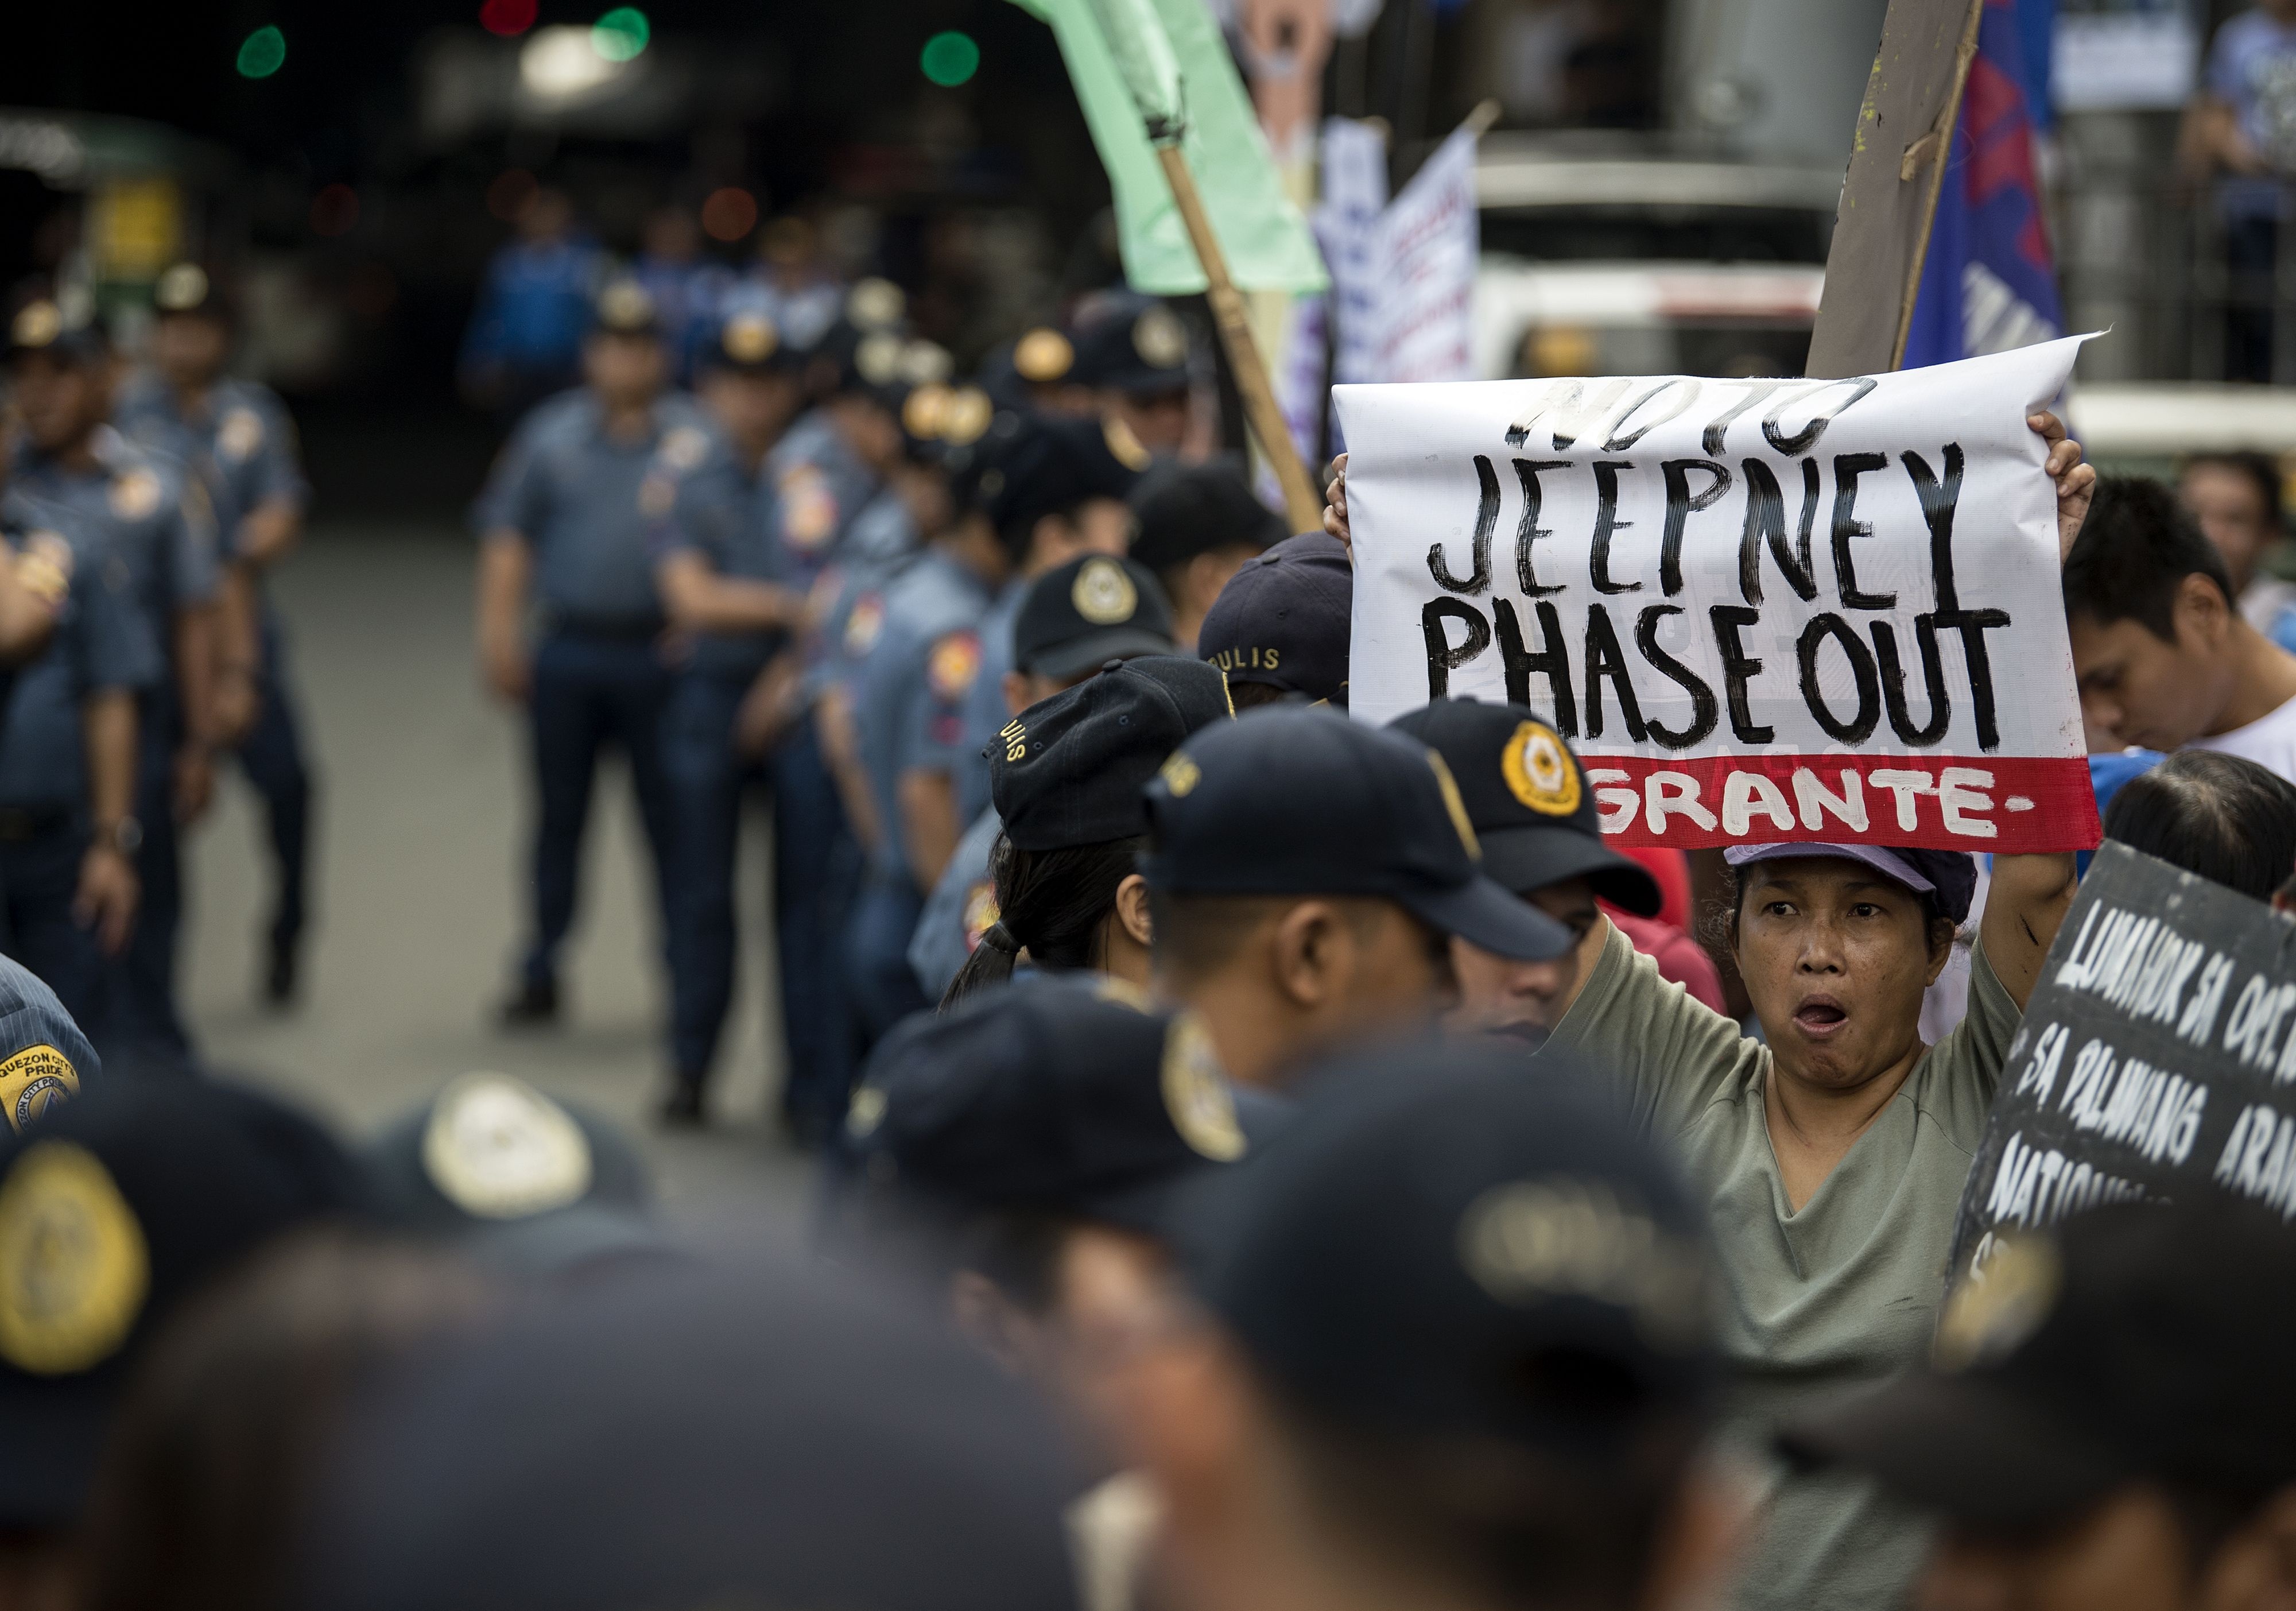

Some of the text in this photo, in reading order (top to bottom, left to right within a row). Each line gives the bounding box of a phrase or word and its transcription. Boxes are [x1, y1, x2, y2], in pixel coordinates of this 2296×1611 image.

[1504, 376, 1878, 457] NO TO
[1426, 442, 1965, 611] JEEPNEY
[1000, 719, 1026, 762] ULIS
[2175, 950, 2235, 1049] SA
[0, 1053, 51, 1078] QUEZON
[23, 1082, 41, 1100] CITY
[25, 1064, 64, 1077] PRIDE
[2015, 1021, 2070, 1110] SA
